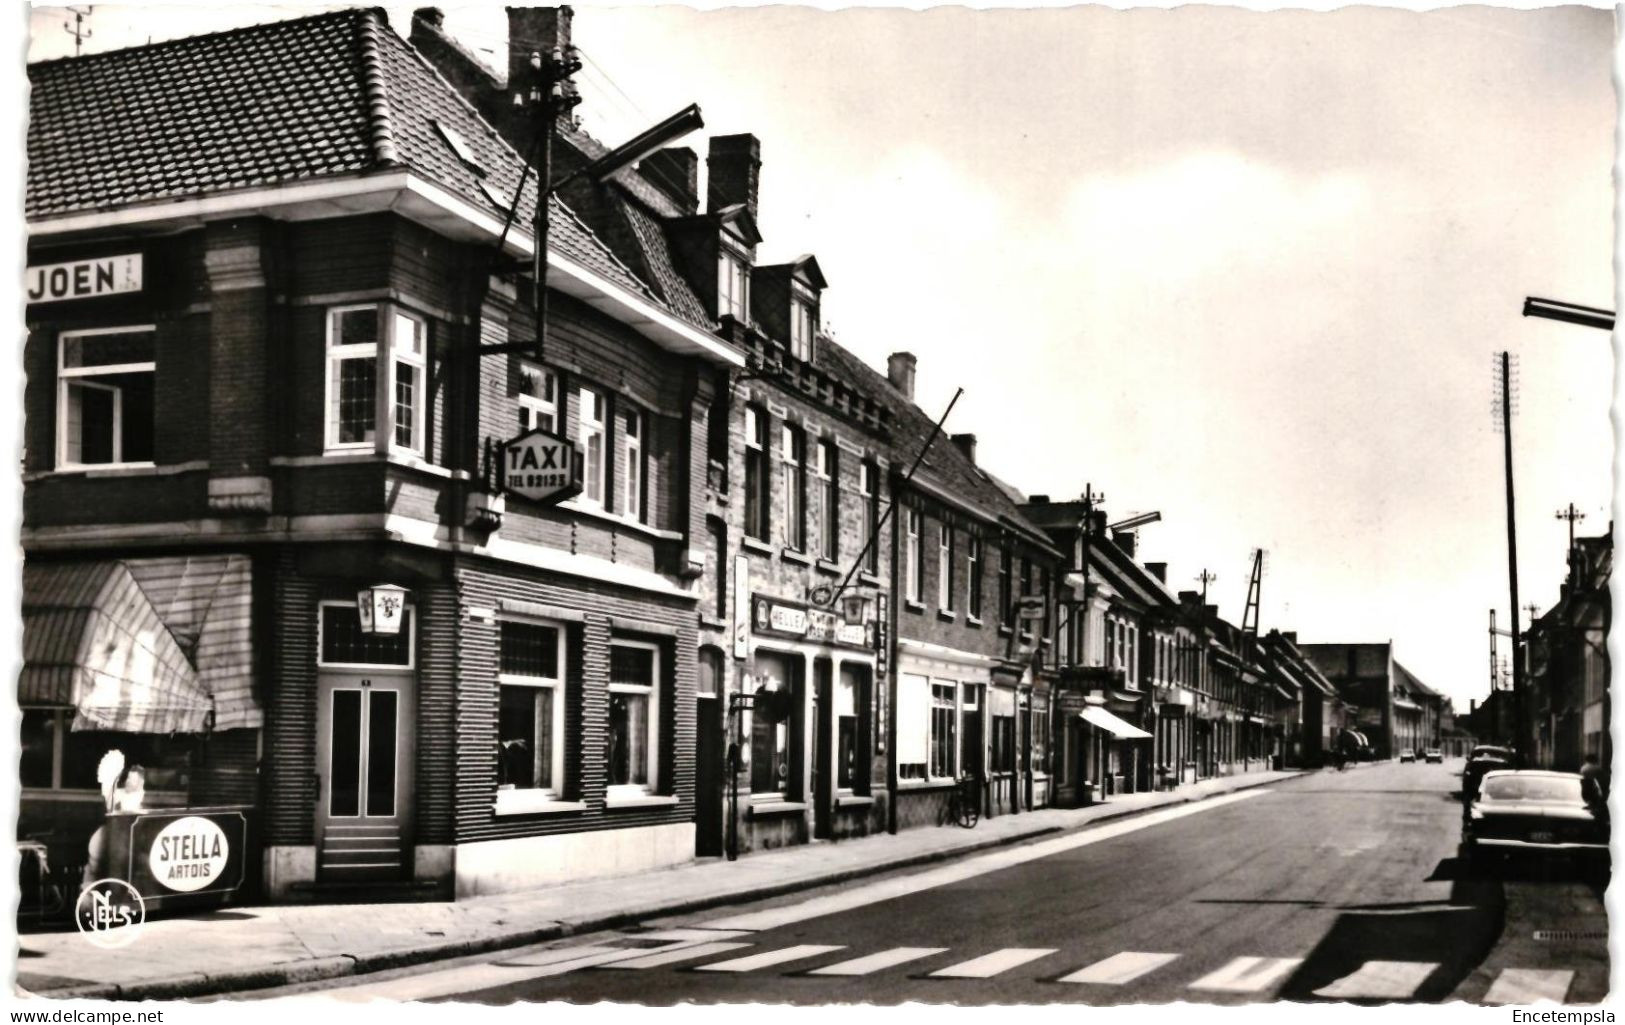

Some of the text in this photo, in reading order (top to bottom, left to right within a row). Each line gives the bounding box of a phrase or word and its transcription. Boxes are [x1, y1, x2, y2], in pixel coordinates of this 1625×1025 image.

[28, 261, 114, 300] JOEN
[508, 445, 567, 470] TAXI
[160, 833, 221, 861] STELLA
[168, 863, 210, 879] ARTOIS
